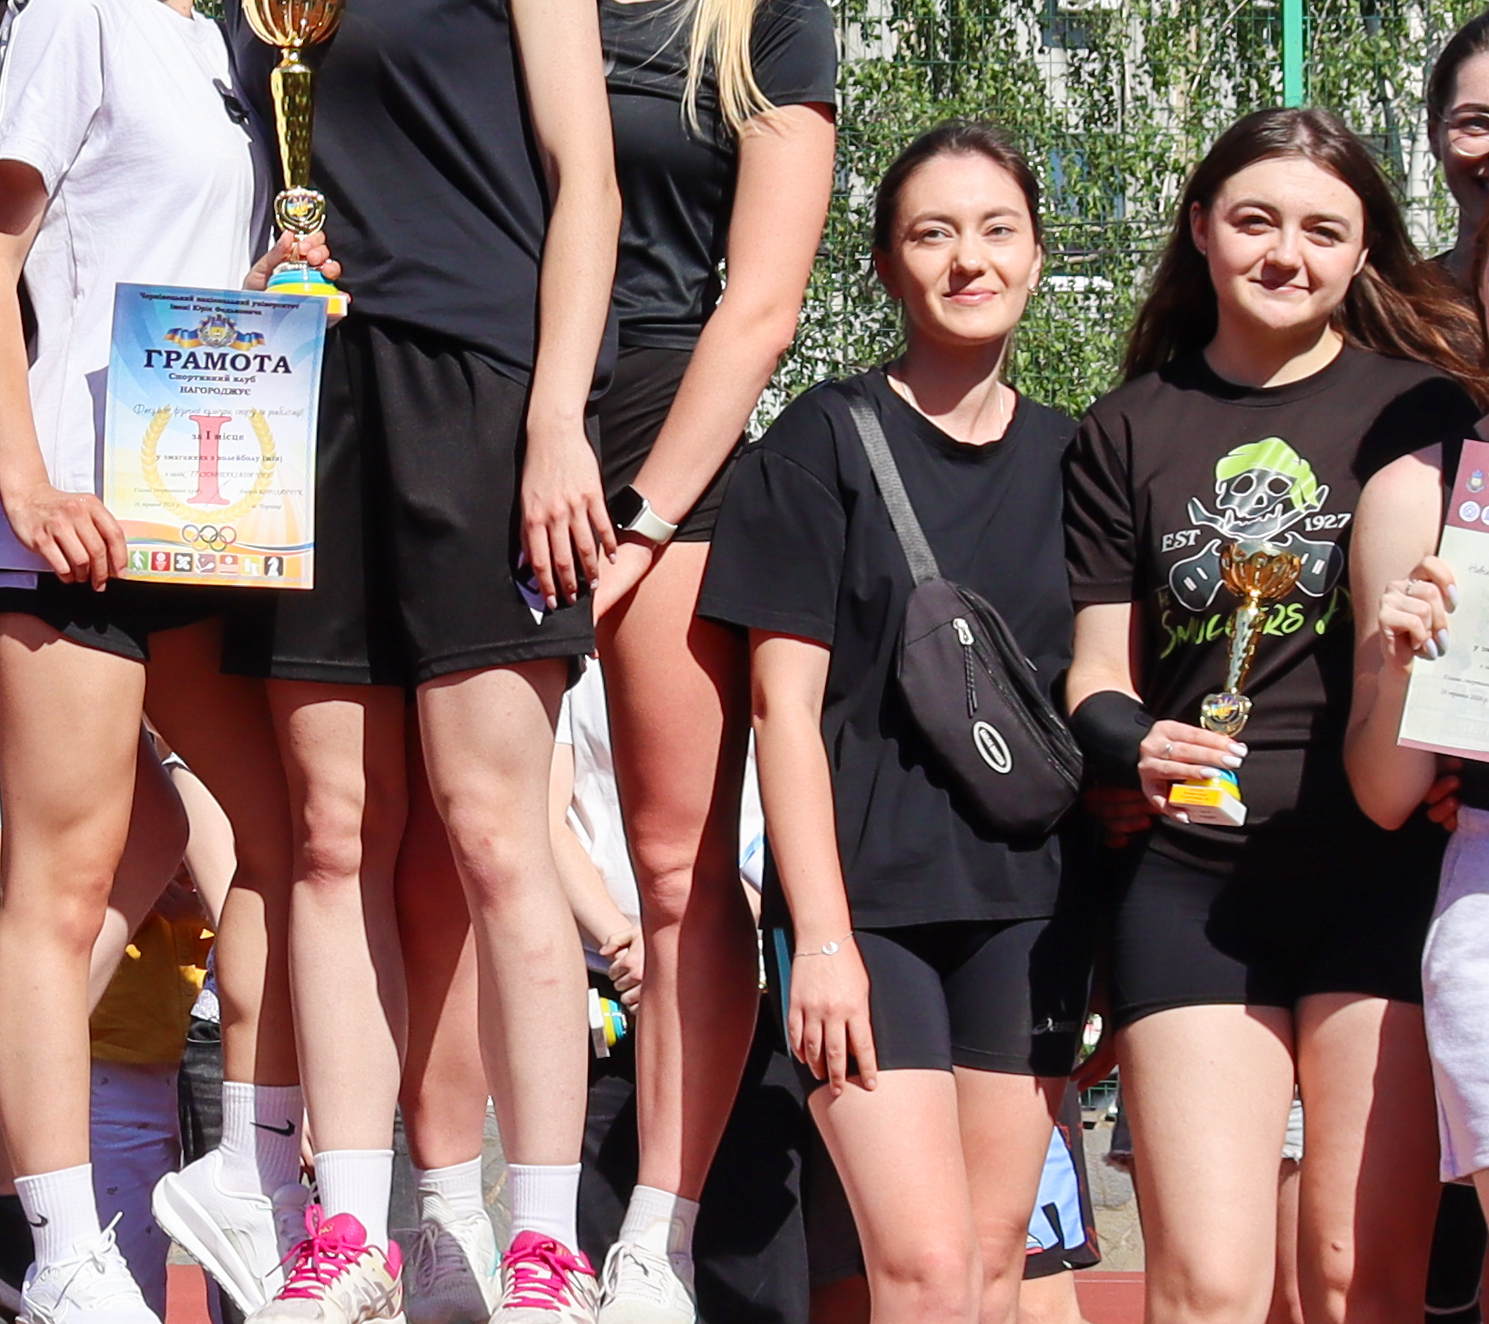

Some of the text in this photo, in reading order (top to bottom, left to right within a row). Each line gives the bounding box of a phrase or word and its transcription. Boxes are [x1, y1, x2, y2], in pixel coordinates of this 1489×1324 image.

[143, 349, 292, 374] ГРАМОТА
[233, 375, 256, 384] клуб
[1161, 513, 1352, 553] EST 1927
